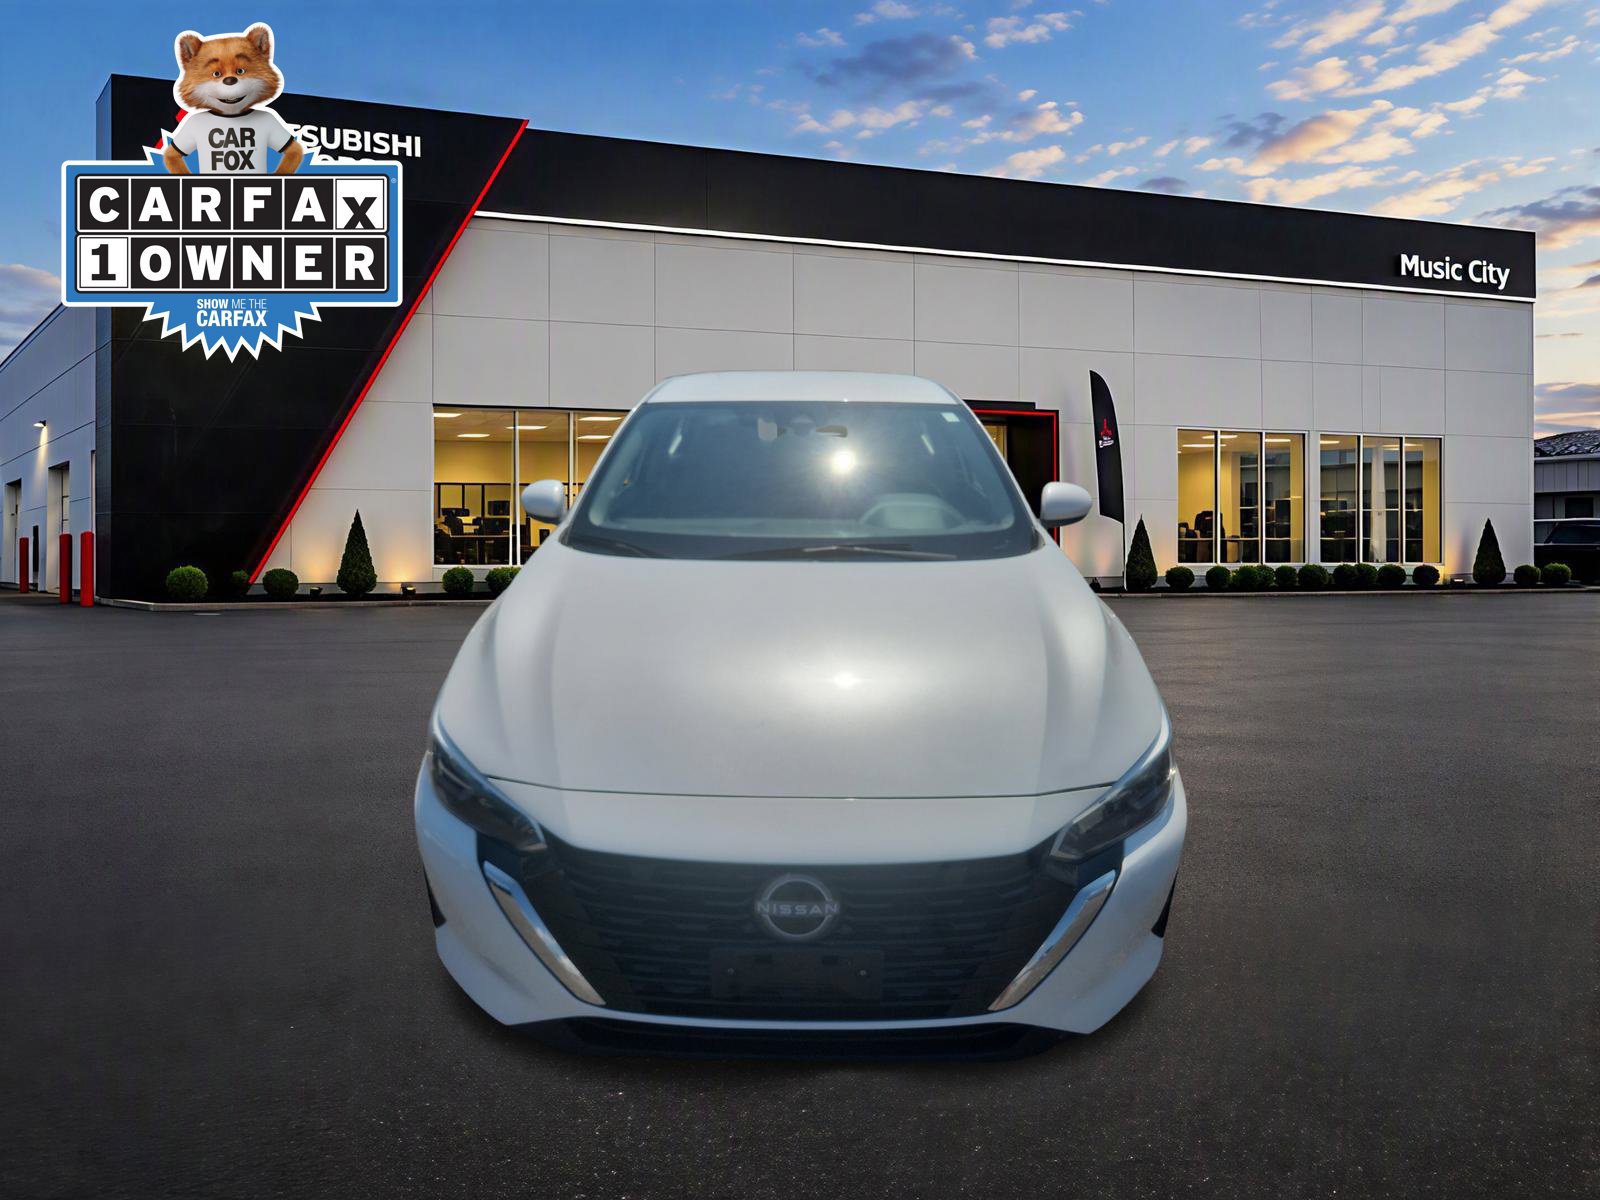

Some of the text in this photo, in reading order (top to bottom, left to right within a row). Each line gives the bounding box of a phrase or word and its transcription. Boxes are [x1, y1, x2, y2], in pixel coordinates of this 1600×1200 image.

[1400, 253, 1511, 290] Music City
[757, 903, 838, 915] NISSAN
